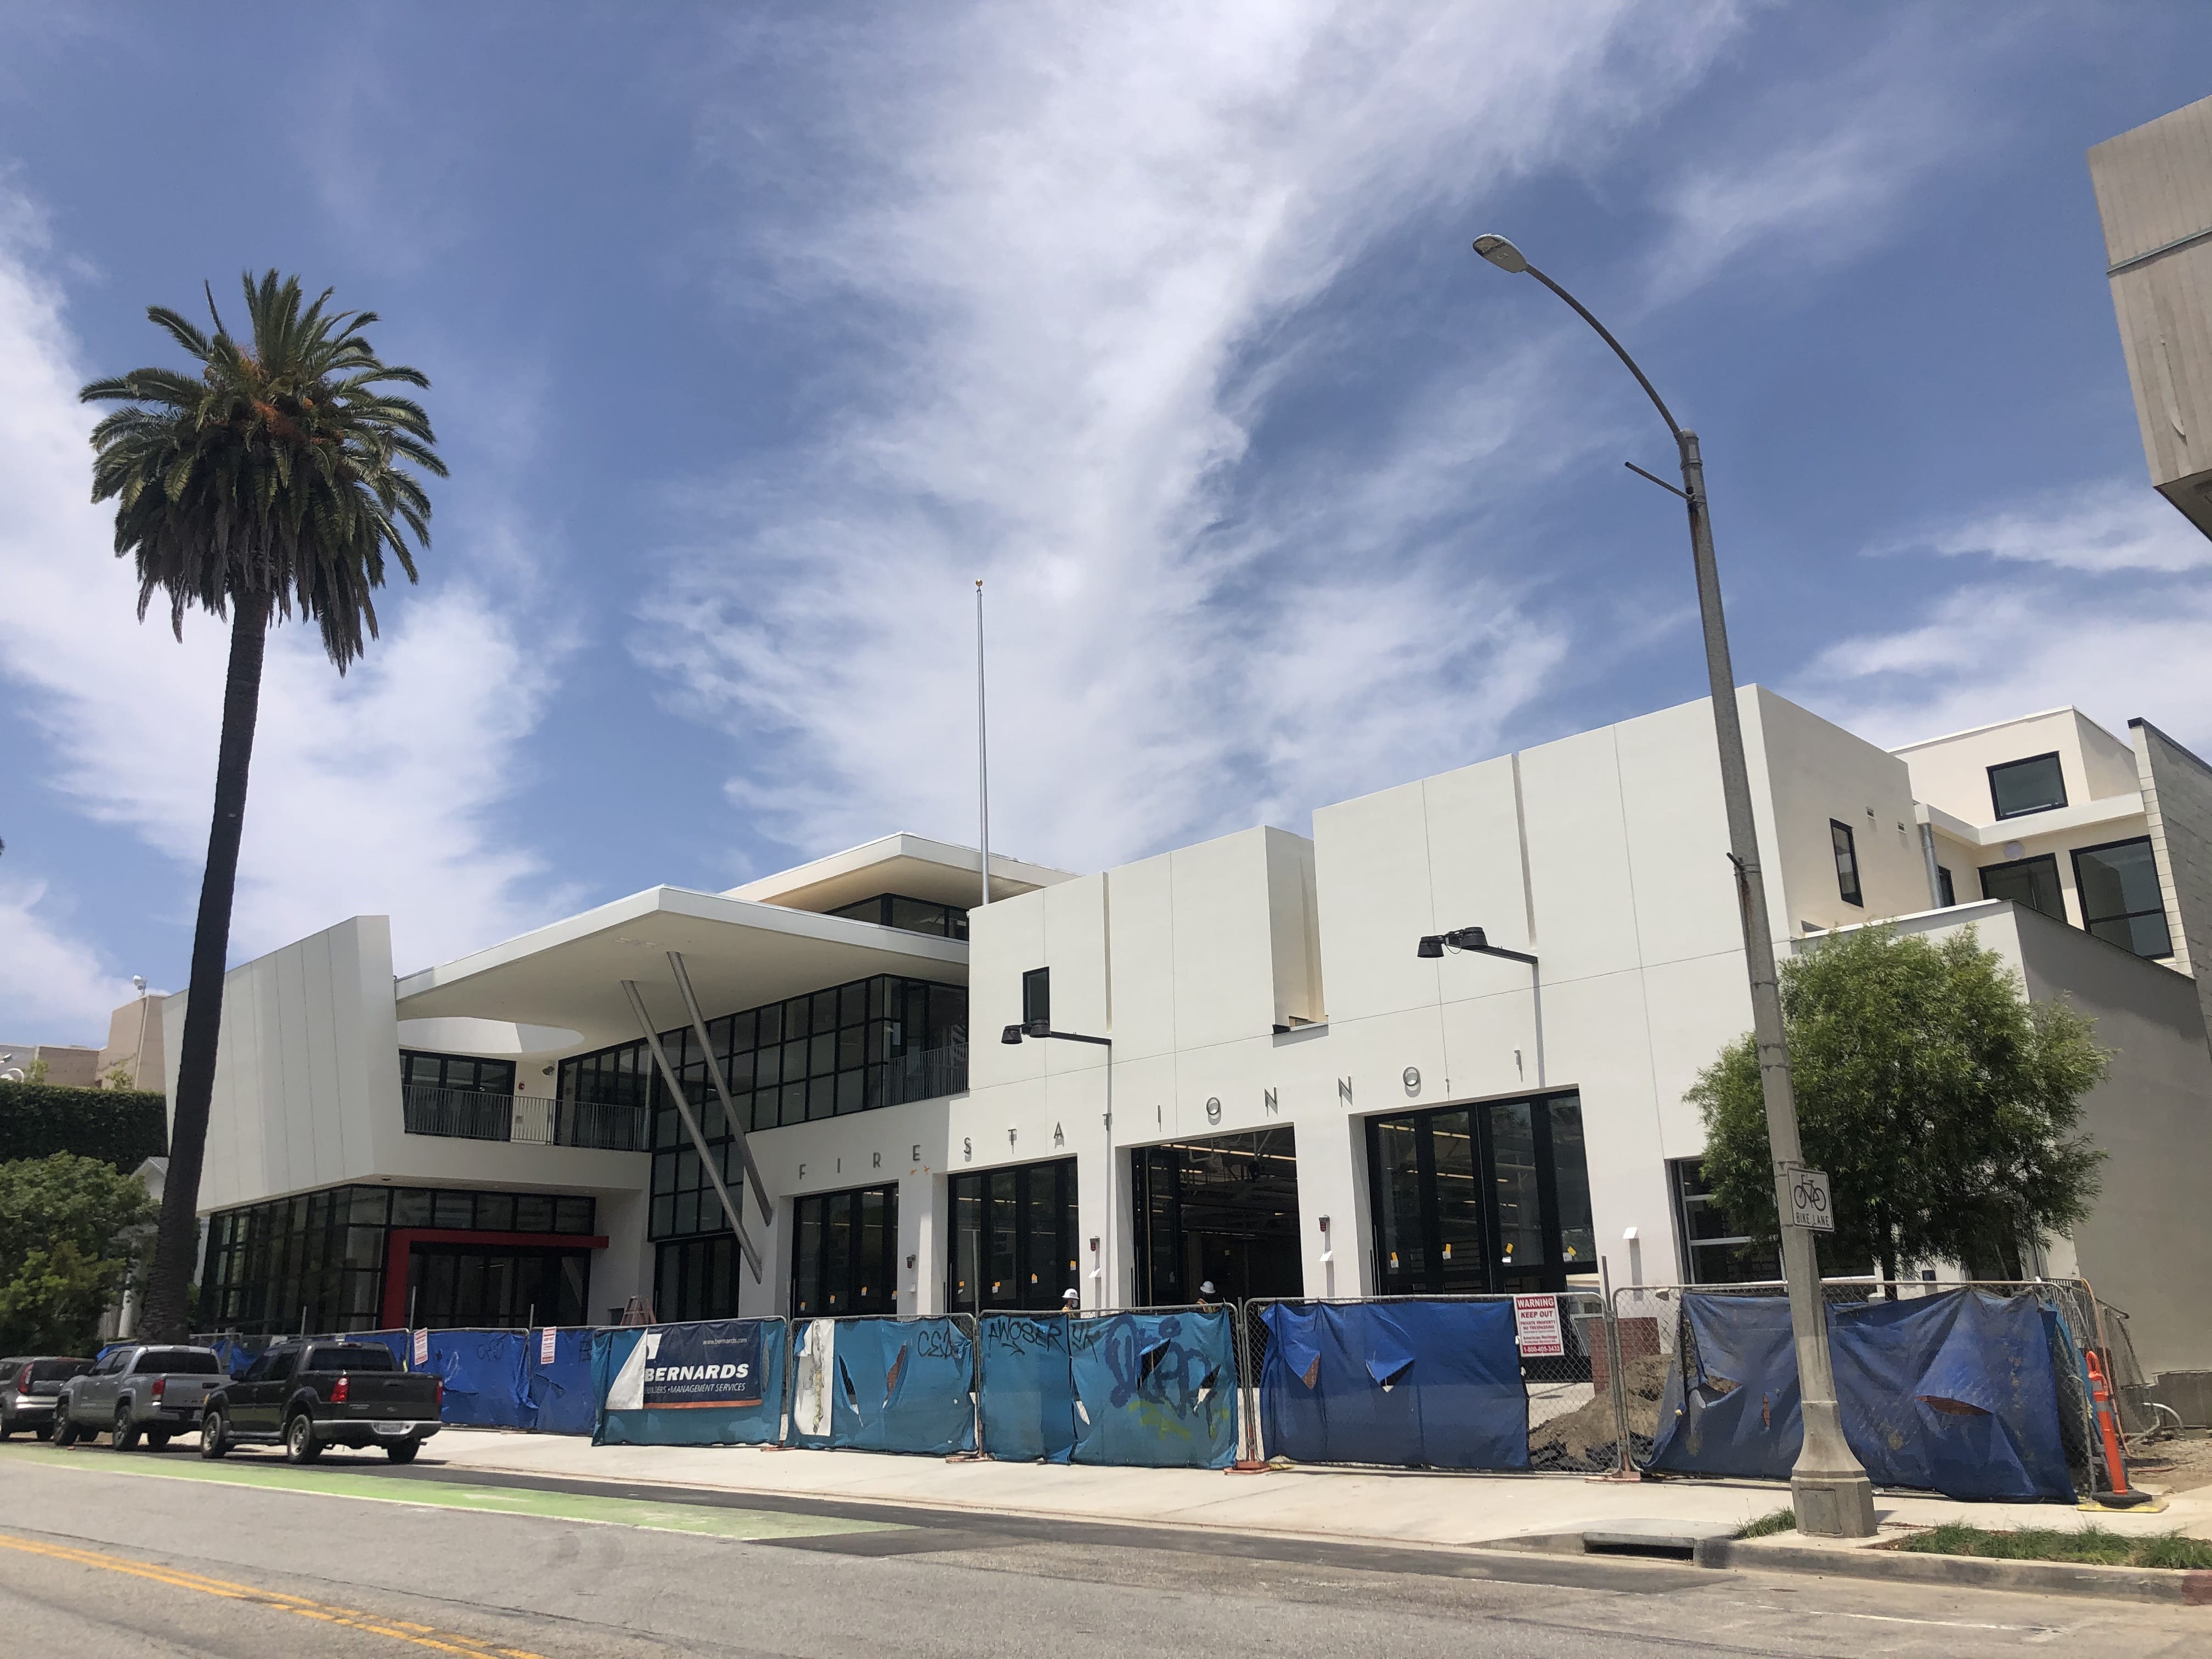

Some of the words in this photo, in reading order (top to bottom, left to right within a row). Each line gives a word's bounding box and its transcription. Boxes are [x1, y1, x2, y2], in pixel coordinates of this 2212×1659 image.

[799, 1144, 921, 1180] FIRE
[963, 1087, 1278, 1155] STATION
[1796, 1212, 1810, 1224] BIKE
[1812, 1214, 1830, 1226] LANE
[1517, 1297, 1554, 1308] WARNING
[645, 1363, 749, 1383] BERNARDS
[670, 1383, 715, 1393] MANAGEMENT
[715, 1382, 746, 1392] SERVICES
